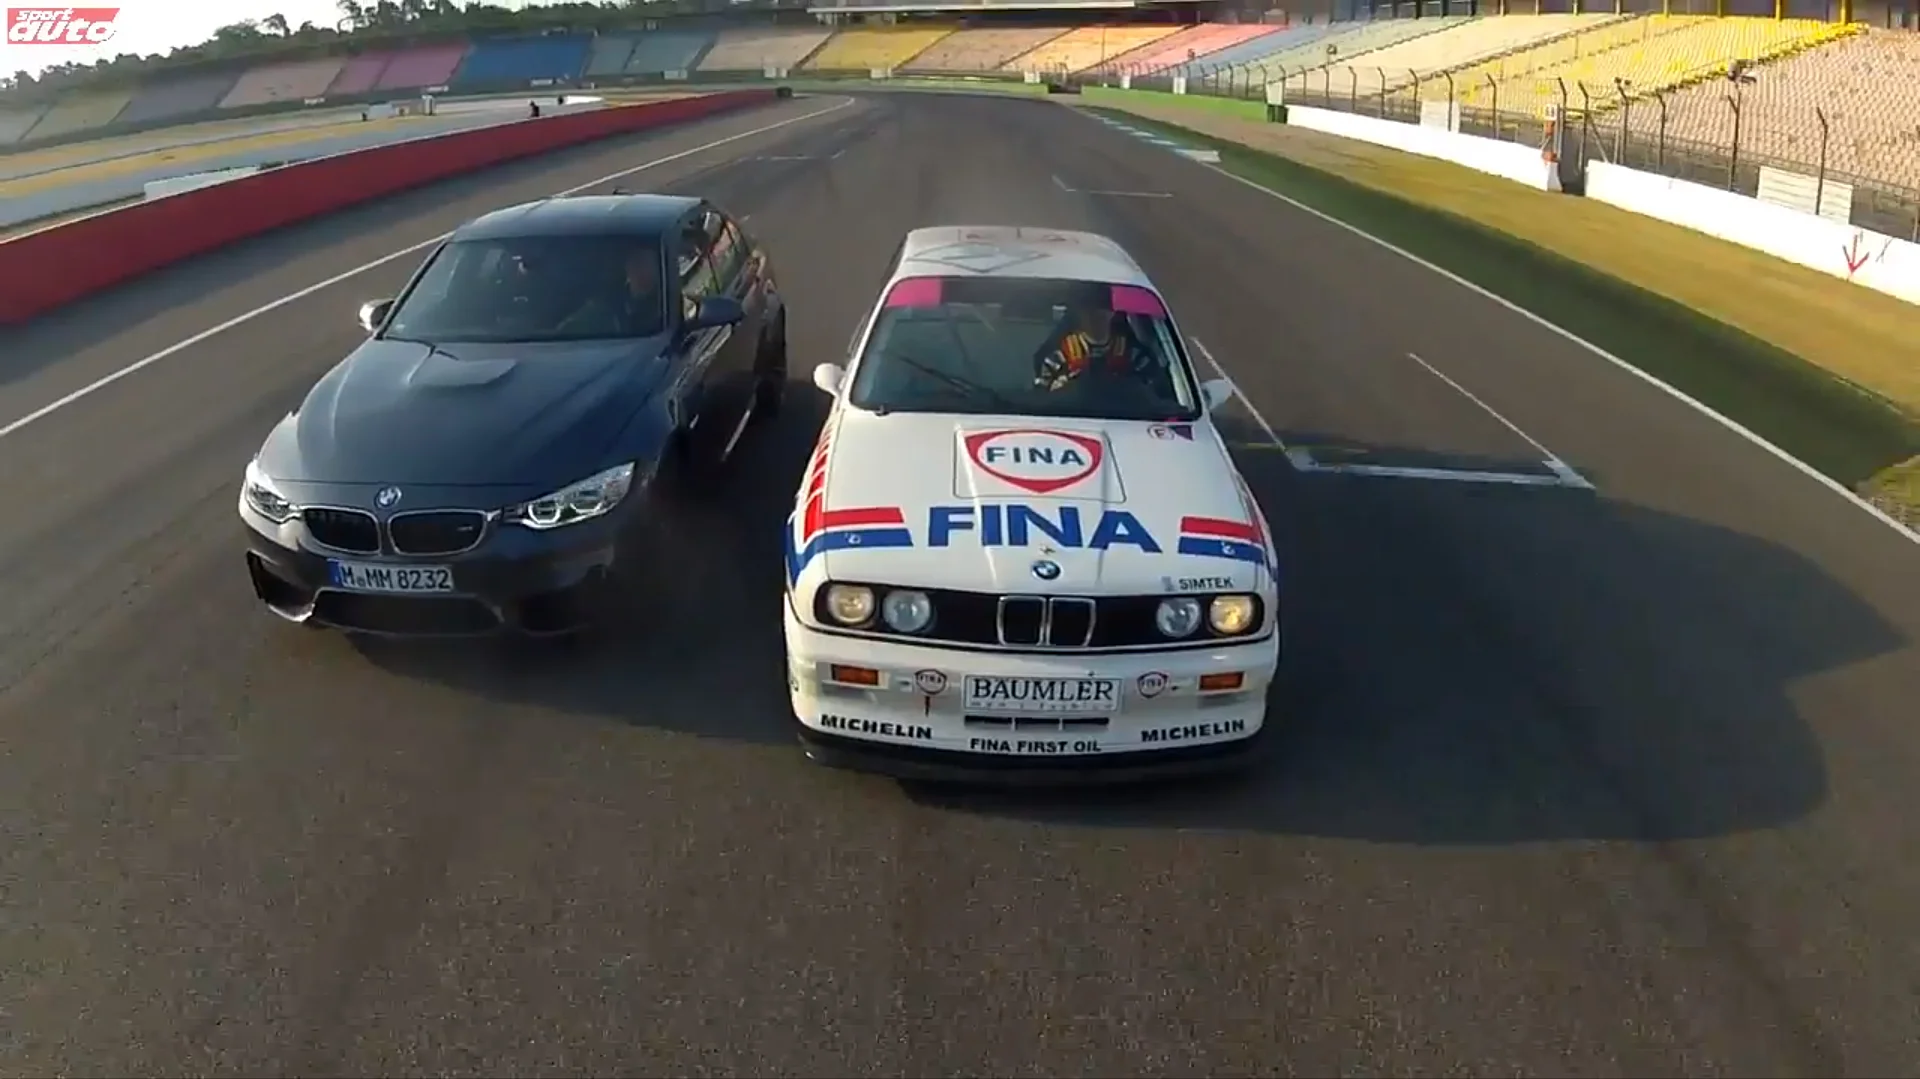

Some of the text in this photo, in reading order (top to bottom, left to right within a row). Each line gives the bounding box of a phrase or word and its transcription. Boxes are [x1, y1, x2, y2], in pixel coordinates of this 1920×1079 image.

[985, 446, 1085, 466] FINA
[928, 504, 1163, 553] FINA
[397, 568, 452, 589] 8232
[1178, 577, 1234, 590] SIMTEK
[820, 713, 932, 739] MICHELIN
[1141, 719, 1245, 742] MICHELIN
[970, 738, 1102, 753] FINA FIRST OIL
